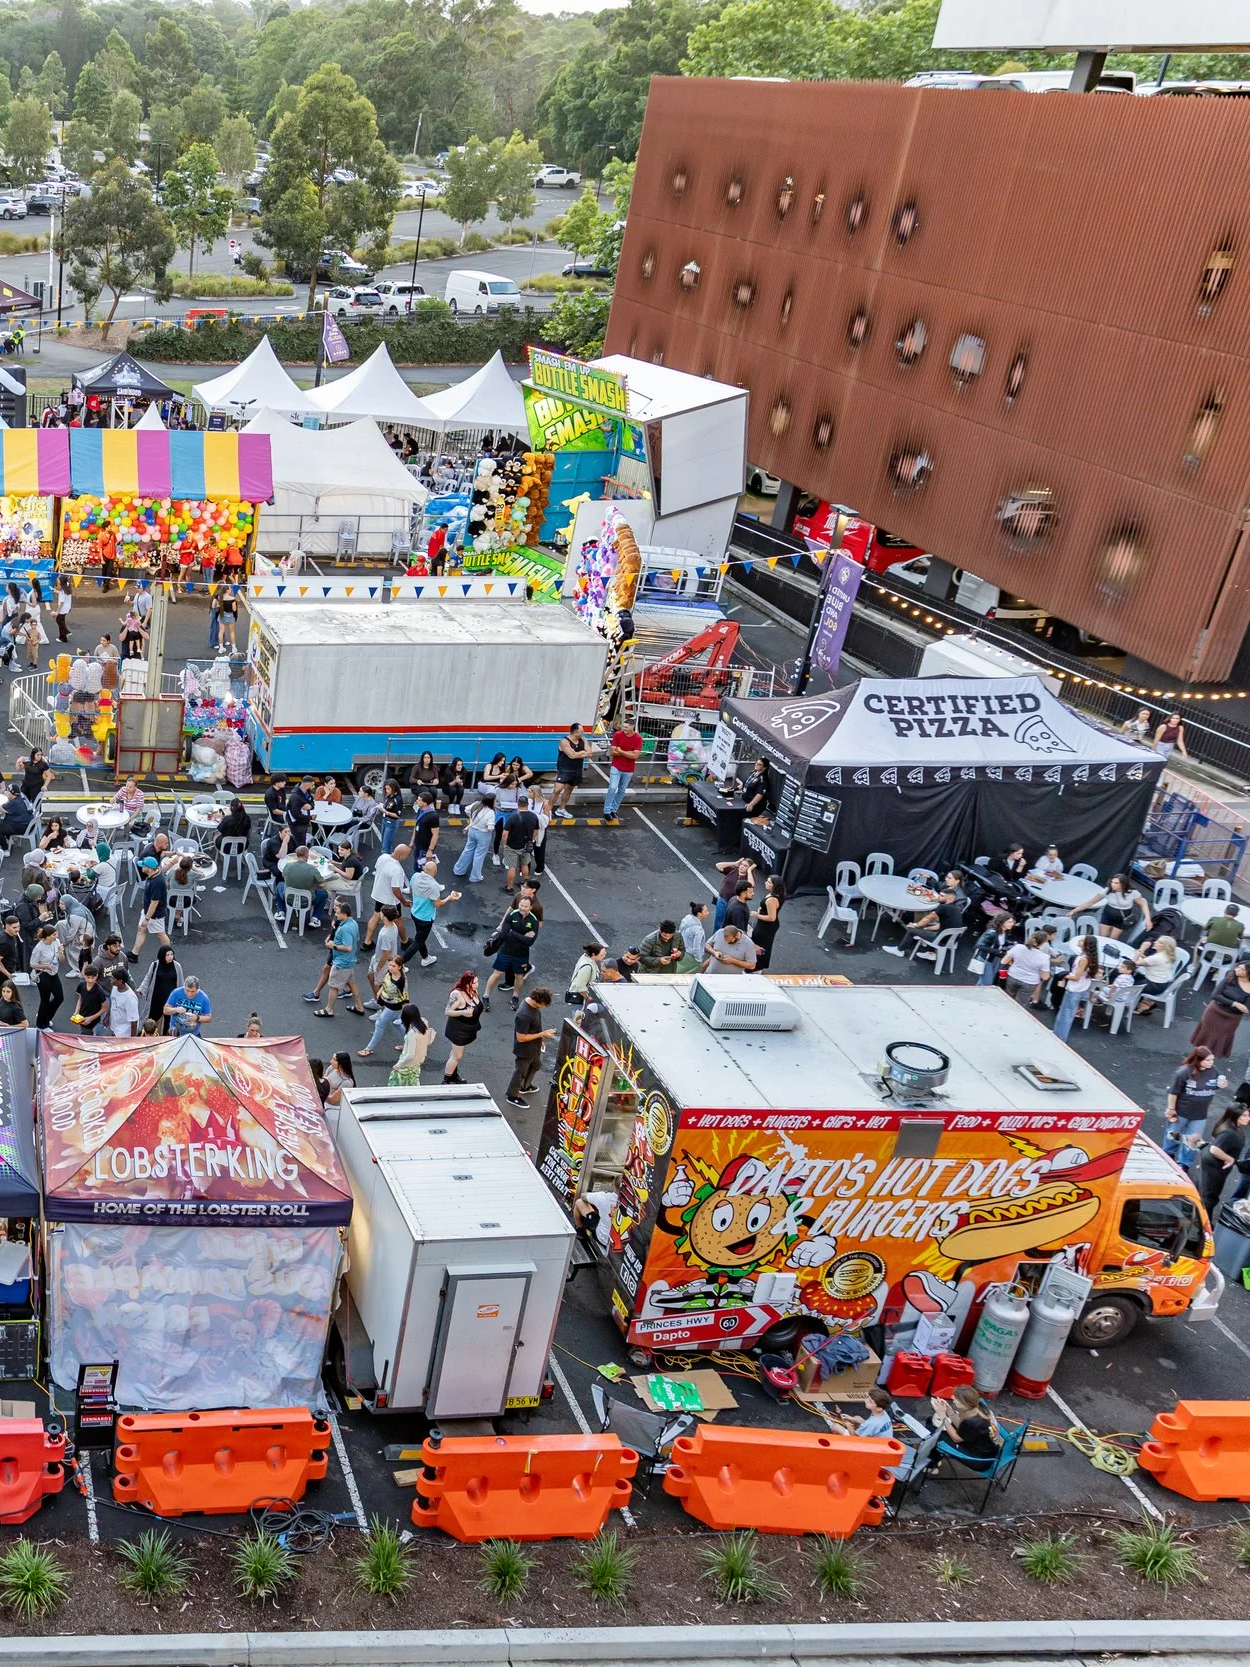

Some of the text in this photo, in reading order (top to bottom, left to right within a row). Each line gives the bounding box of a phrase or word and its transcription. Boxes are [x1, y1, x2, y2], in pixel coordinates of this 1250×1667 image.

[534, 353, 561, 368] SMASH
[580, 365, 590, 375] UP
[534, 362, 579, 397] BOTTLE
[580, 374, 626, 412] SMASH
[864, 692, 1042, 716] CERTIFIED
[889, 716, 1010, 739] PIZZA
[50, 1084, 77, 1132] EAFOOD
[698, 1114, 721, 1128] HOT
[722, 1114, 752, 1128] DOGS
[762, 1114, 811, 1129] BURGERS
[822, 1114, 855, 1129] CHIPS
[867, 1115, 889, 1129] HOT
[952, 1115, 980, 1130] FOOD
[1029, 1115, 1057, 1130] PUPS
[1067, 1115, 1096, 1132] COLD
[549, 1145, 561, 1165] CALL
[540, 1163, 570, 1197] NEXT EVENT
[545, 1155, 570, 1184] FOR YOUR
[727, 1152, 1053, 1199] DAPTO'S HOT DOGS
[94, 1202, 310, 1217] HOME OF THE LOBSTER ROLL
[770, 1198, 971, 1242] & BURGERS
[829, 1260, 840, 1273] HOME
[827, 1275, 879, 1297] BIG MICK BURGER
[640, 1315, 736, 1332] PRINCES HWY 60
[653, 1329, 691, 1342] Dapto
[516, 1397, 526, 1406] 56
[81, 1415, 112, 1423] KENNARDS
